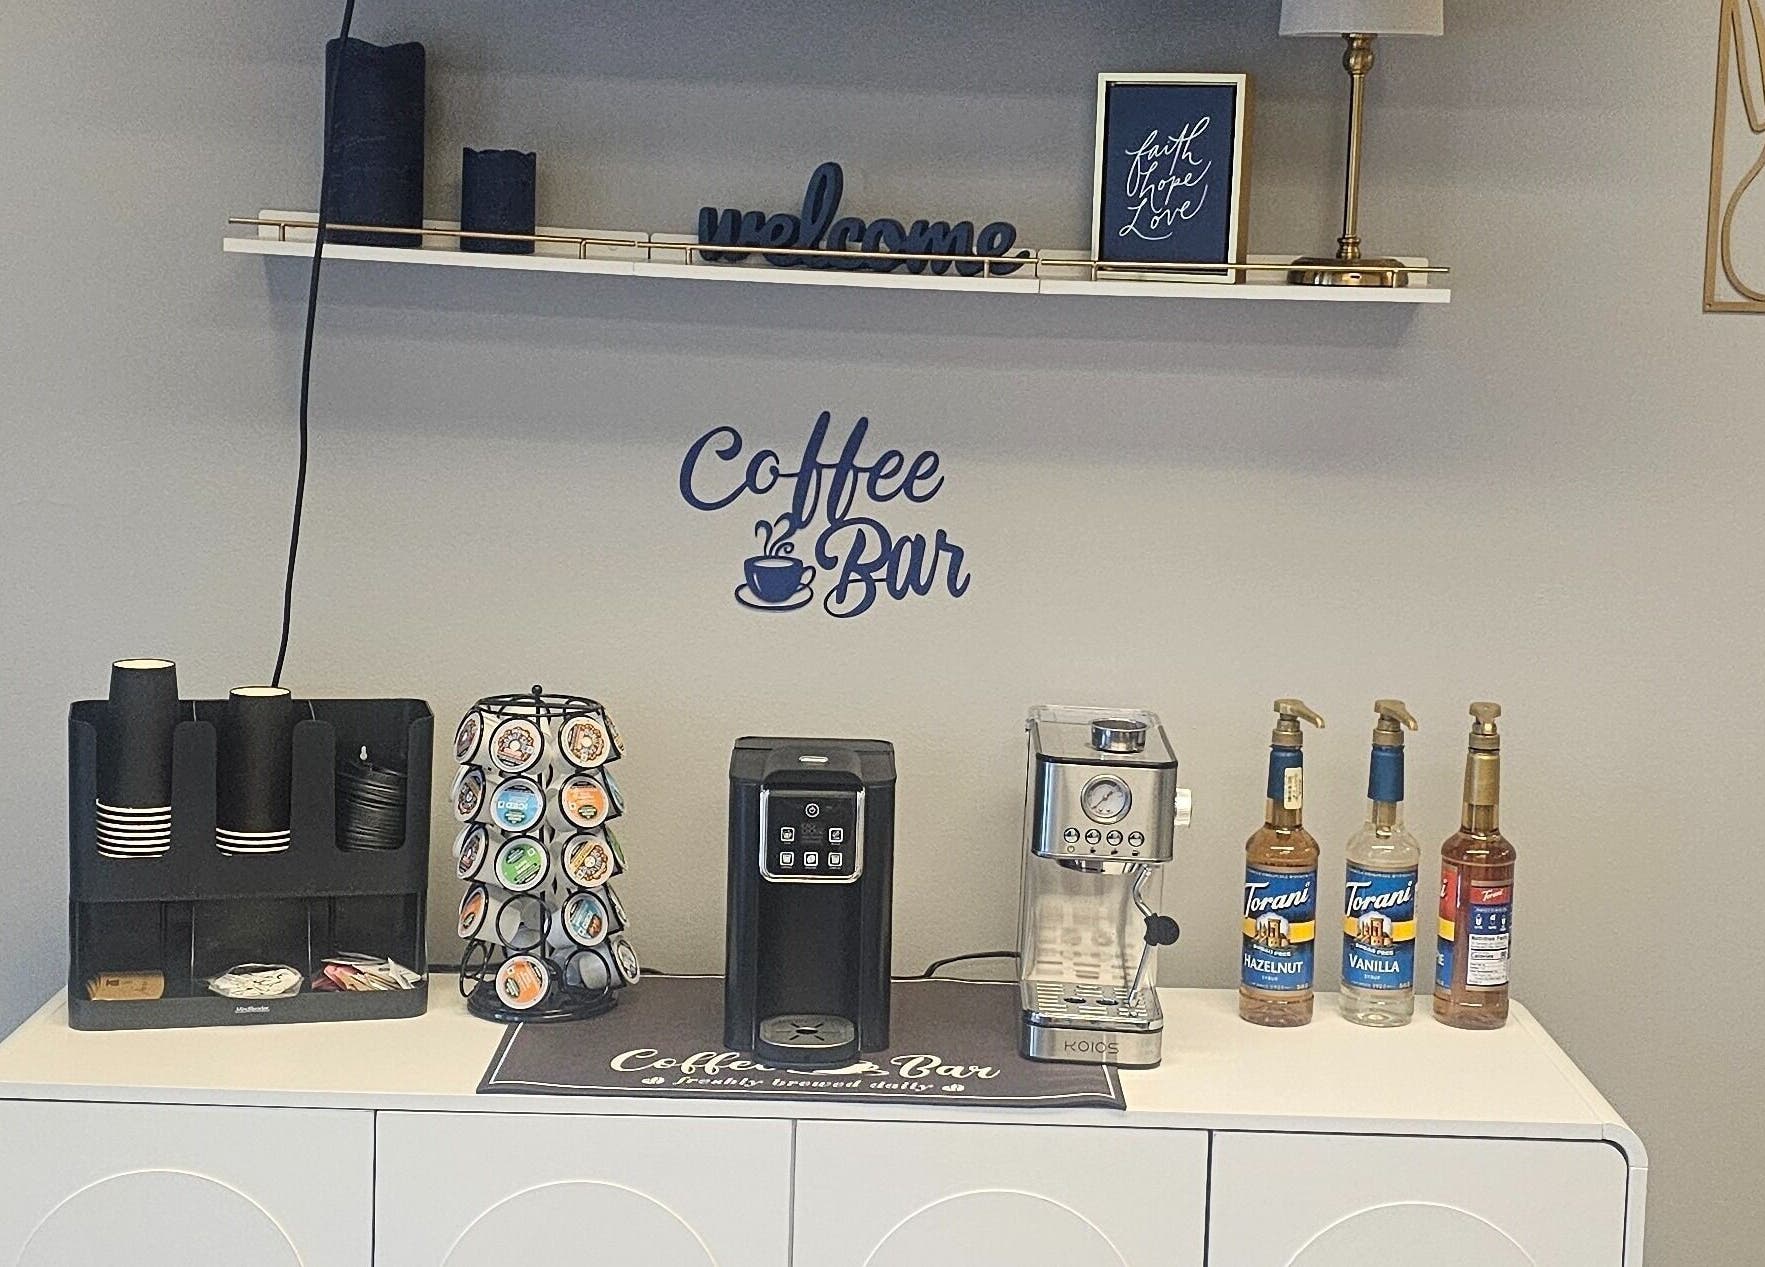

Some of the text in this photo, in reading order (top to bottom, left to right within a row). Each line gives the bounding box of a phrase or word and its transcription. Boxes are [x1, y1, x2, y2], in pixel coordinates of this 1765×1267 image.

[1125, 116, 1210, 197] faith
[1139, 161, 1211, 213] hope
[698, 162, 1030, 277] welcome
[1119, 184, 1208, 240] Love
[680, 411, 945, 528] Coffee
[815, 517, 970, 618] Bar
[1244, 881, 1310, 917] Torani
[1345, 880, 1412, 917] Torani
[1244, 953, 1303, 974] HAZELNUT
[1349, 953, 1400, 973] VANILLA
[1064, 1041, 1120, 1054] KOIOS
[672, 1076, 934, 1092] freshly brewed daily
[890, 1054, 1001, 1079] Bar
